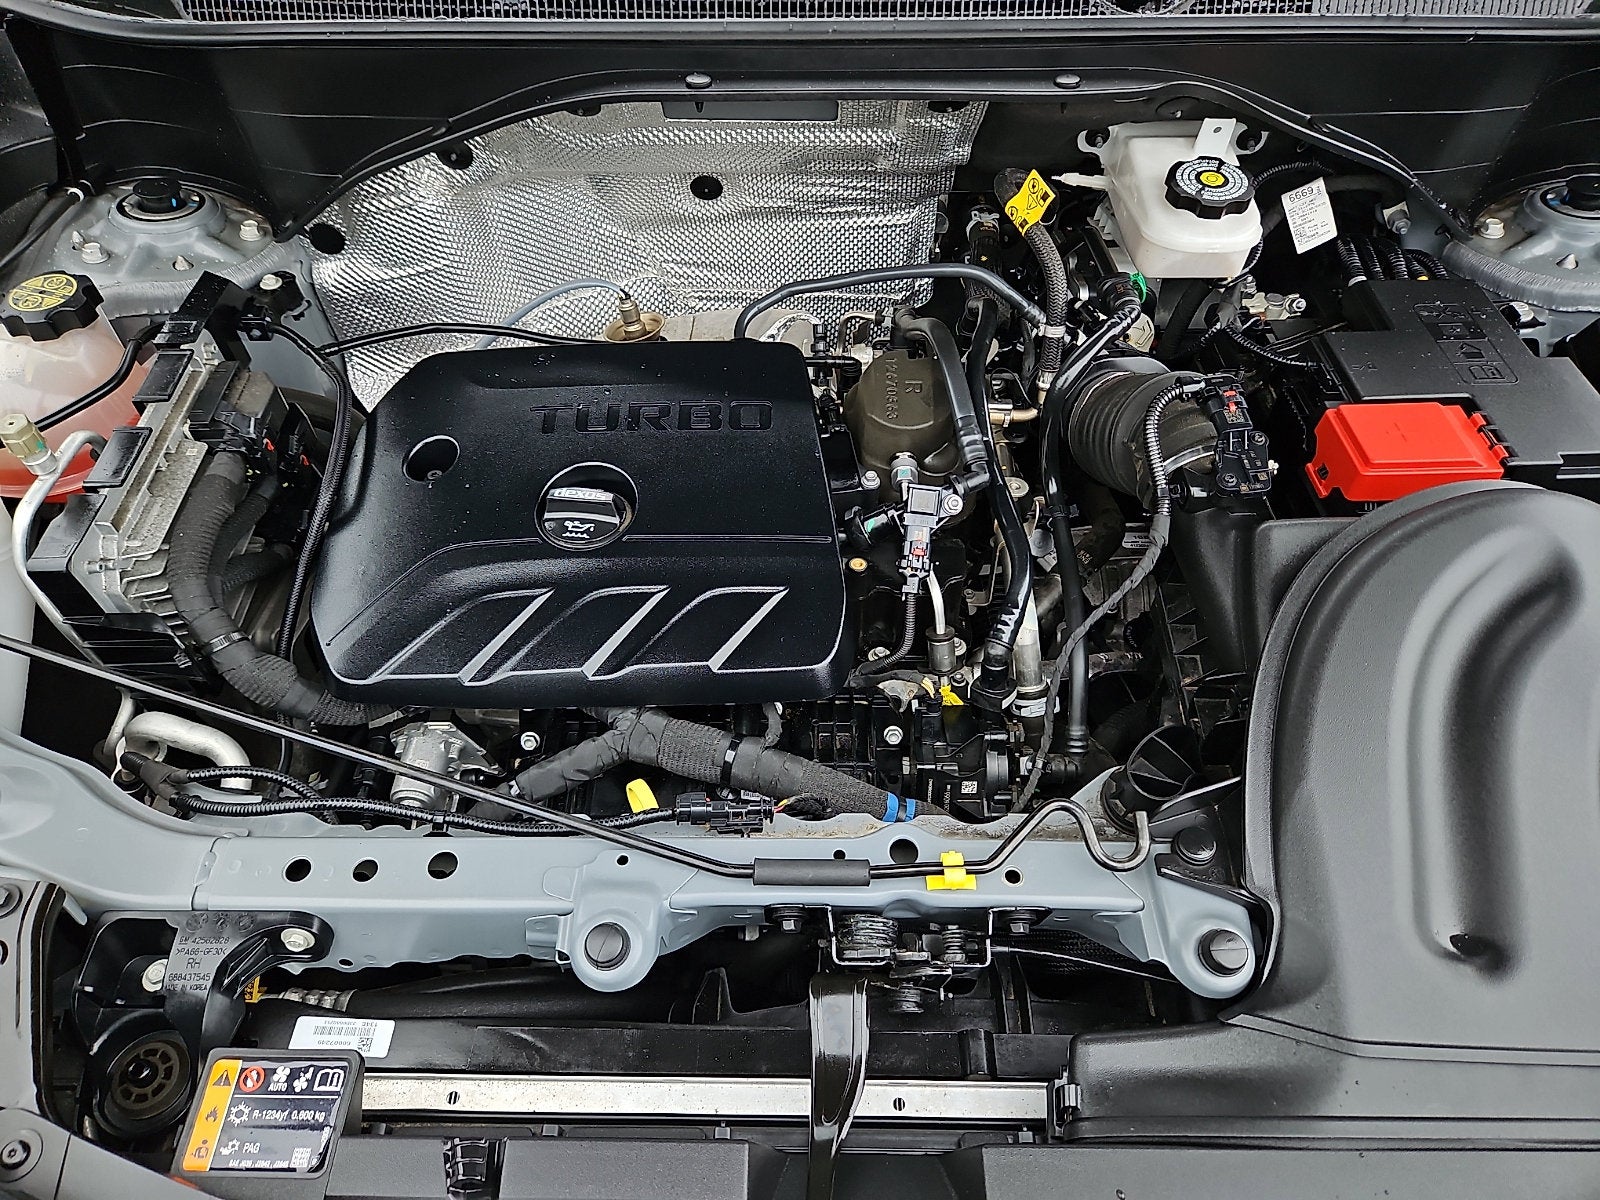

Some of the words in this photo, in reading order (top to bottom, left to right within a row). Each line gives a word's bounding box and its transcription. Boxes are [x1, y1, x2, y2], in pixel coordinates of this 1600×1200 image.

[1288, 186, 1314, 202] 6669
[529, 400, 773, 434] TURBO
[553, 488, 607, 501] dexos
[185, 957, 203, 969] RH
[268, 1082, 288, 1092] AUTO
[252, 1108, 289, 1121] R-1234yf
[291, 1109, 315, 1121] 0.600
[314, 1109, 326, 1122] kg
[242, 1142, 261, 1154] PAG
